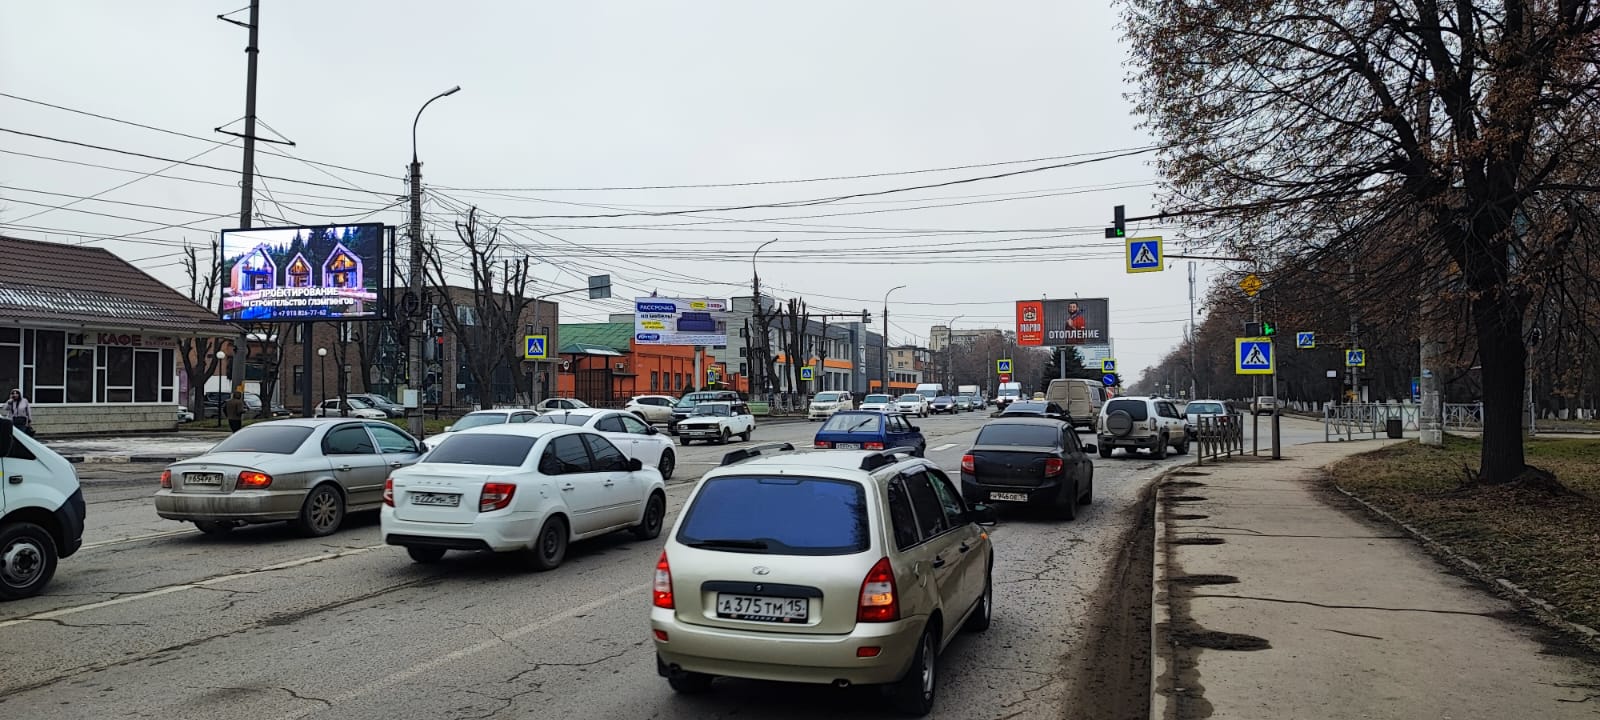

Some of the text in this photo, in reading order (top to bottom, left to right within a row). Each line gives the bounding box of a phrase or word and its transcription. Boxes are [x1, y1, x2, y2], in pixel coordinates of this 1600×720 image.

[258, 287, 339, 298] ПРОЕКТИРОВАНИЕ
[250, 298, 307, 307] СТРОИТЕЛЬСТВО
[1048, 329, 1100, 339] ОТОПЛЕНИЕ
[97, 332, 142, 347] КАФЕ
